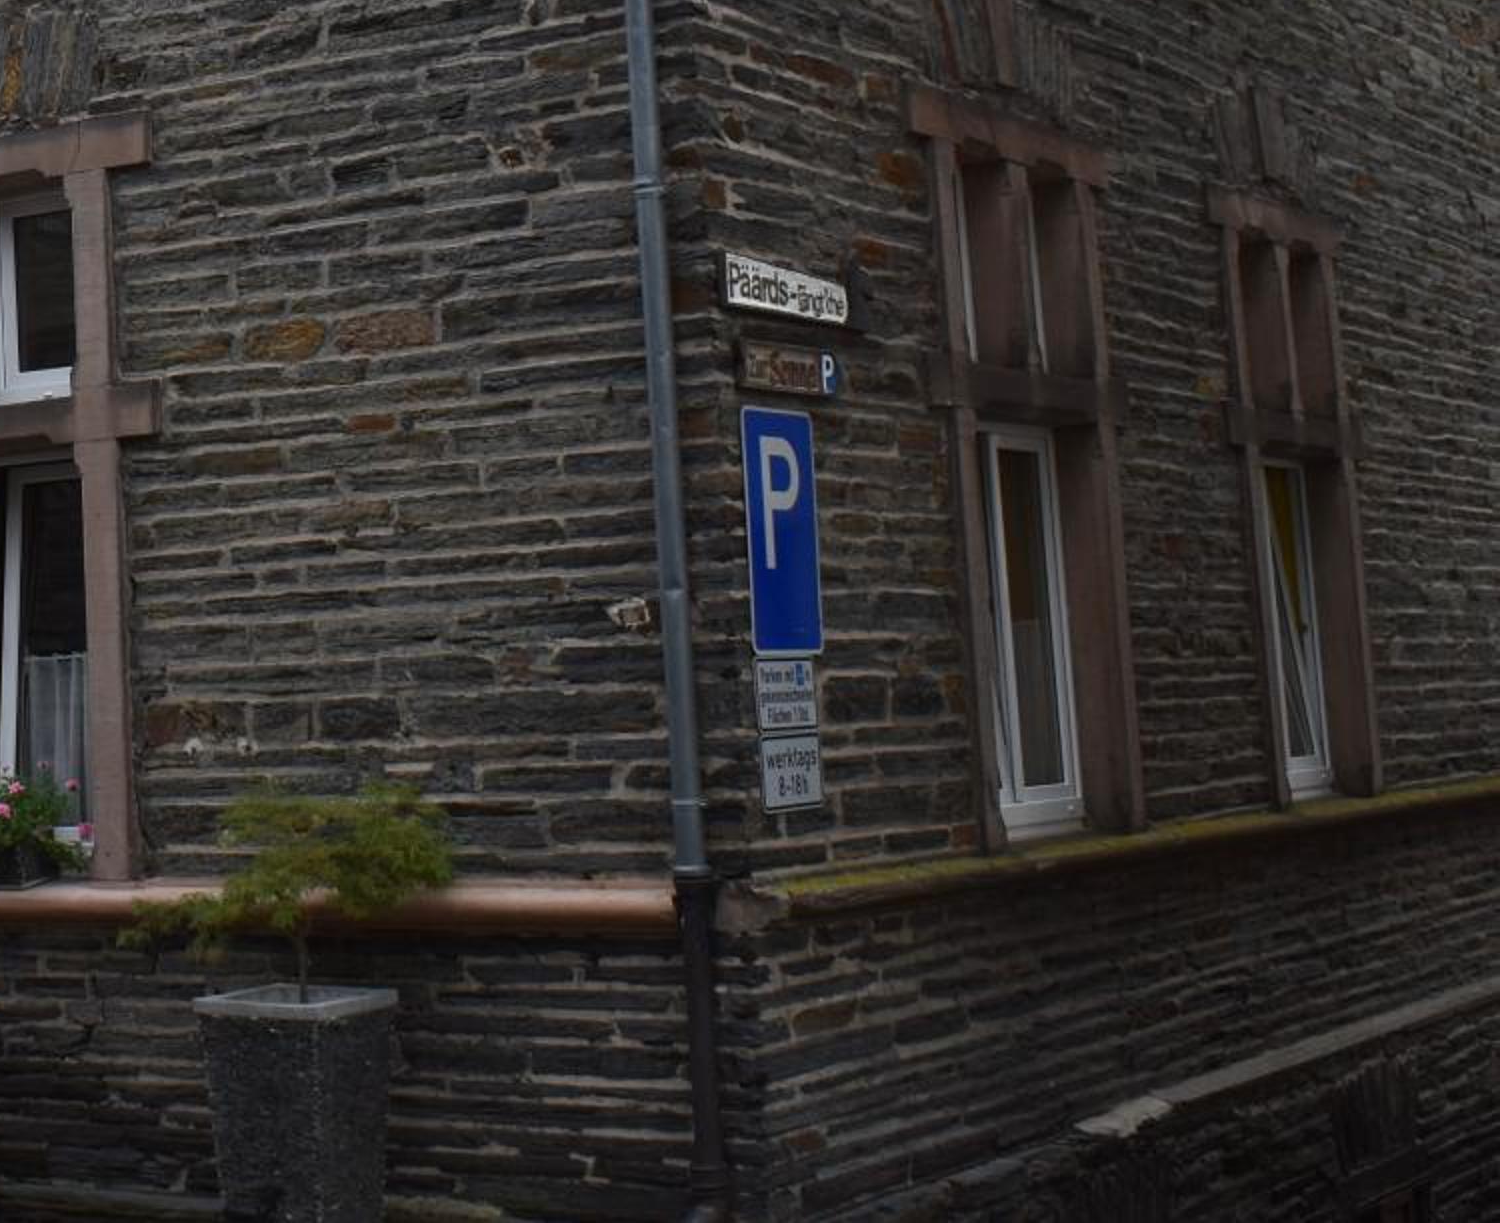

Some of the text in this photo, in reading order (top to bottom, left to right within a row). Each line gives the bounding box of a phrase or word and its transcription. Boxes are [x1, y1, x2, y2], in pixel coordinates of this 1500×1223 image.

[821, 354, 835, 394] P
[759, 436, 799, 570] P
[766, 747, 817, 772] werktags
